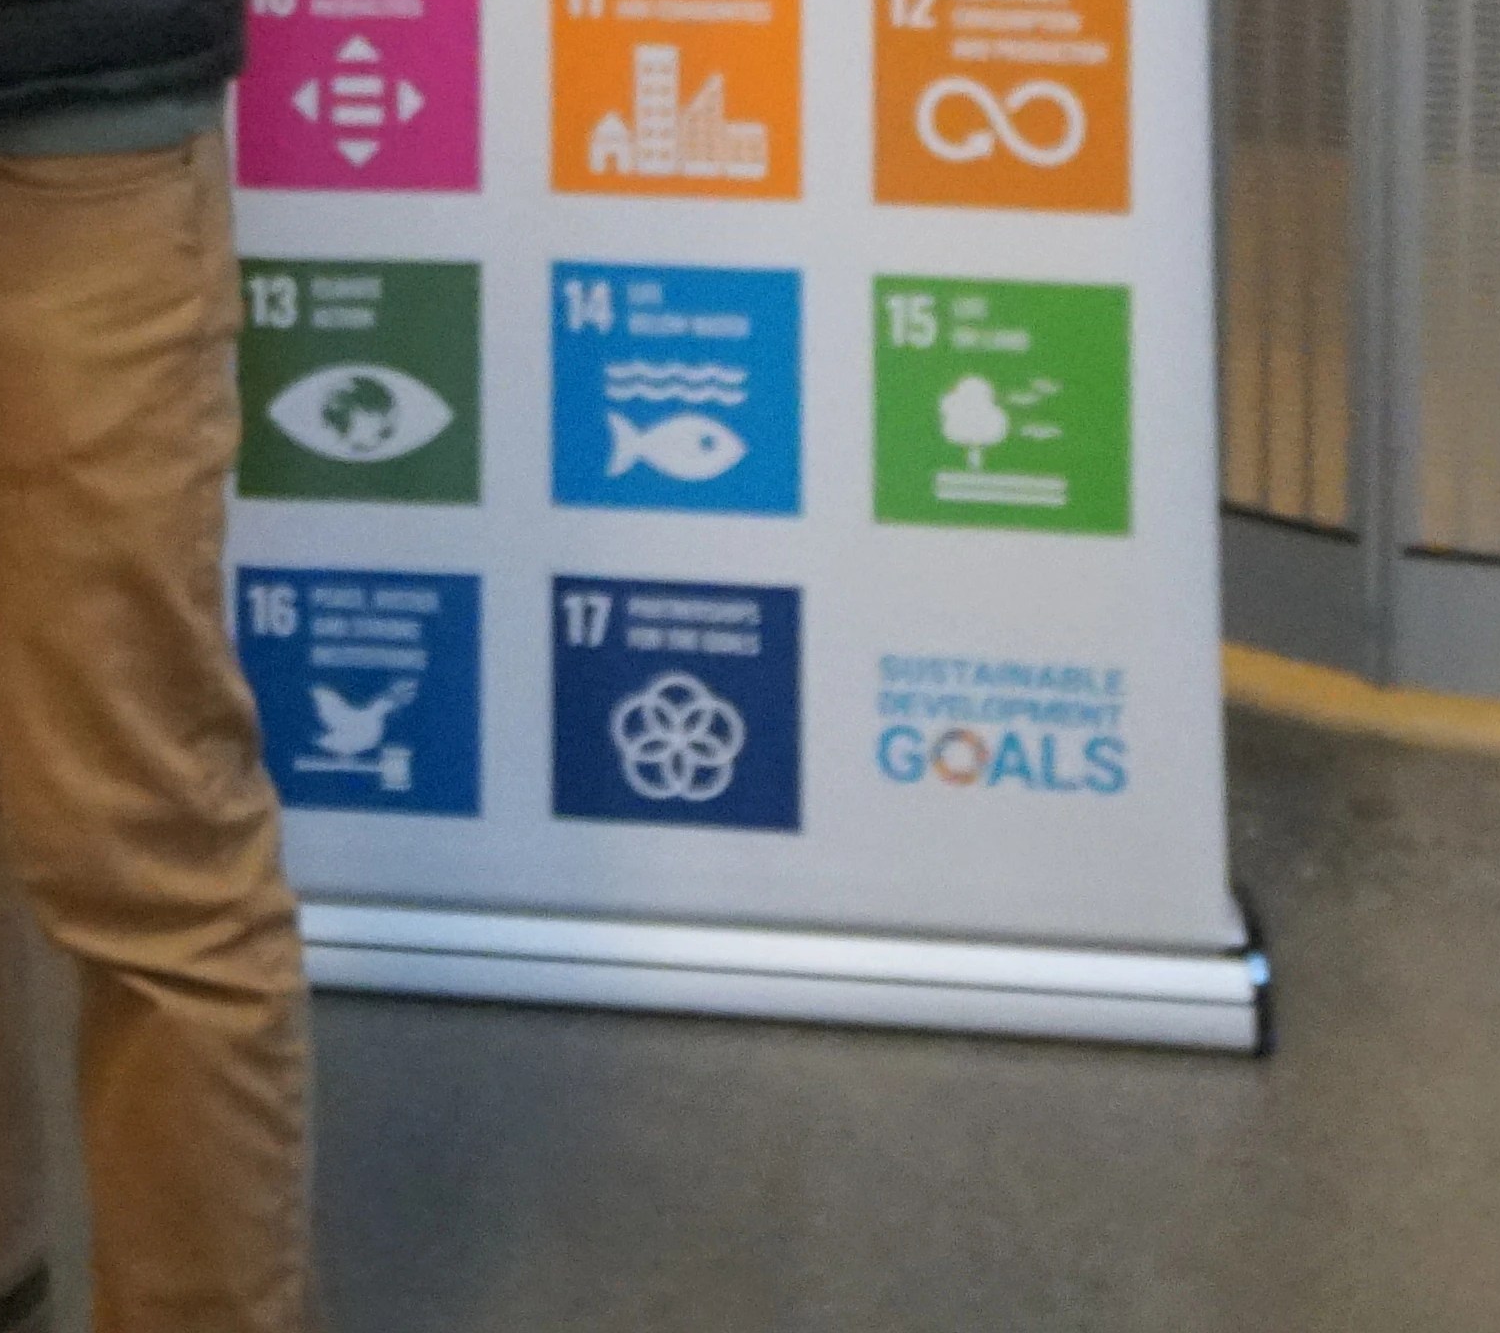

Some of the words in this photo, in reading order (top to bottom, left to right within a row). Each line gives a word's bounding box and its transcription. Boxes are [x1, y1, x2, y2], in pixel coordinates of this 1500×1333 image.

[248, 275, 298, 329] 13
[564, 279, 613, 333] 14
[886, 293, 937, 349] 15
[247, 584, 297, 637] 16
[563, 592, 613, 648] 17
[878, 654, 1127, 697] SUSTAINABLE
[876, 690, 1124, 728] DEVELOPMENT
[875, 724, 1128, 795] GOALS
